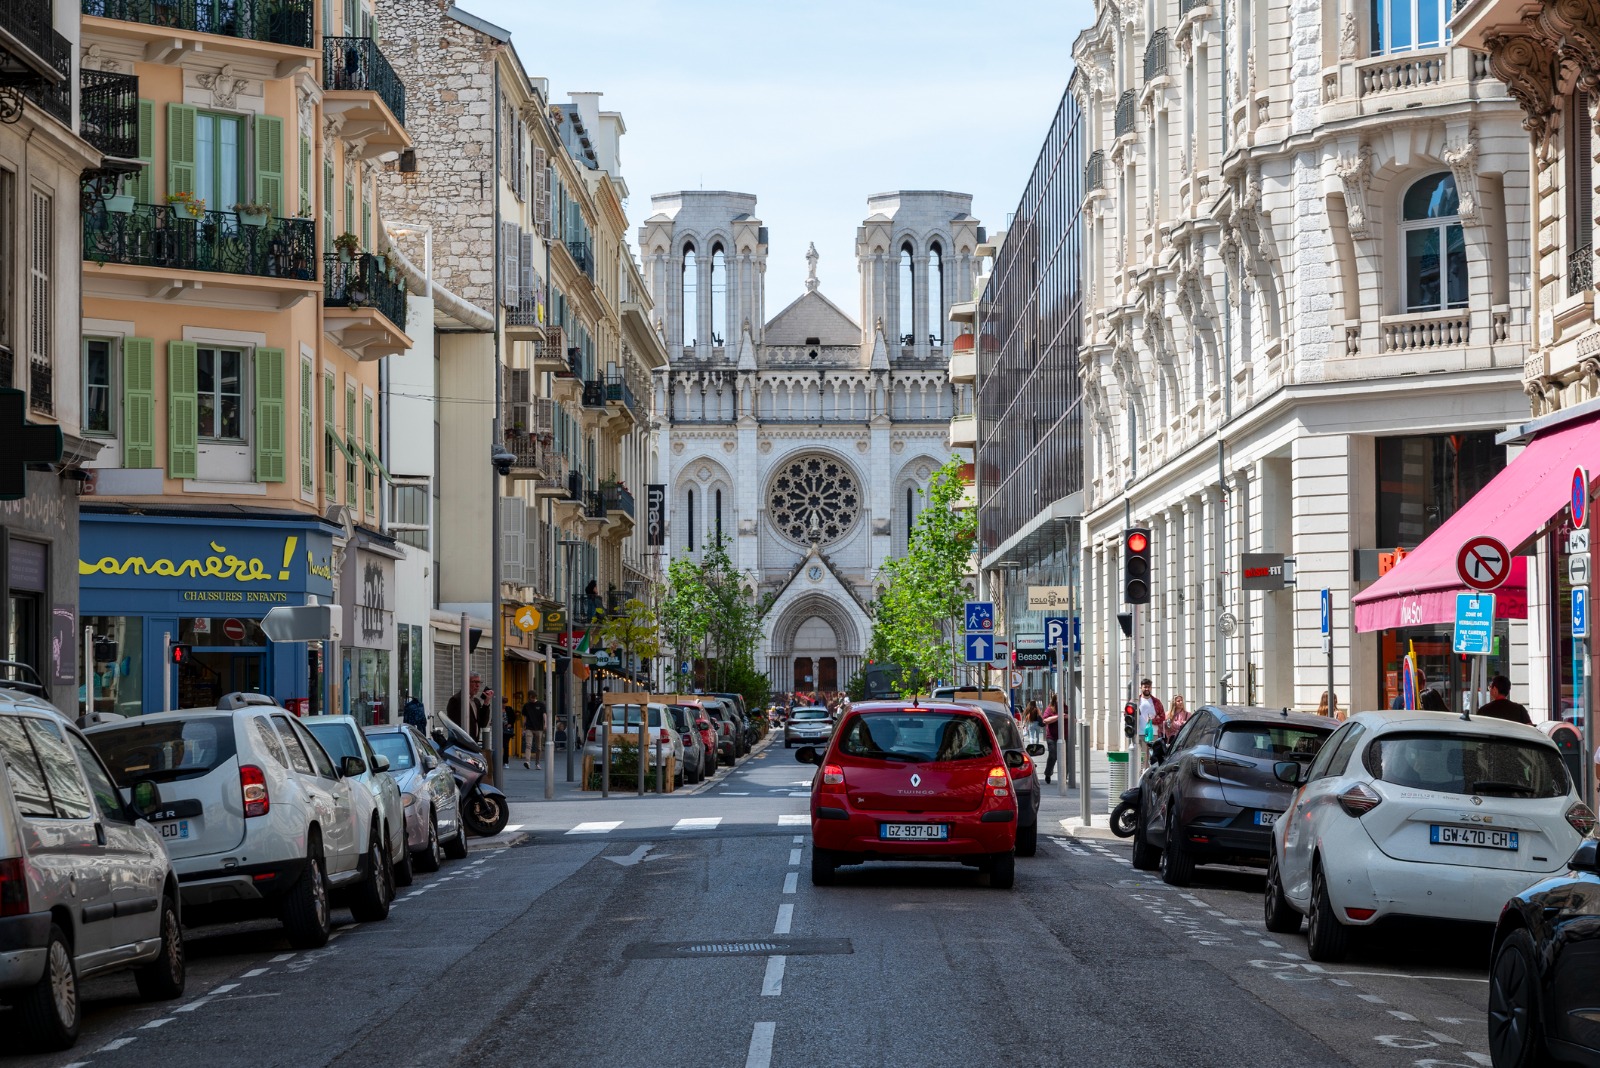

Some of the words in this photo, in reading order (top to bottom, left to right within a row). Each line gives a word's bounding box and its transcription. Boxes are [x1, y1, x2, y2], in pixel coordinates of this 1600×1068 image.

[649, 490, 663, 536] fnac
[79, 541, 272, 581] ananère
[184, 591, 242, 601] CHAUSSURES
[247, 592, 287, 601] ENFANTS
[1322, 597, 1327, 626] P
[1048, 623, 1062, 644] P
[888, 825, 939, 837] GZ-937-QJ
[1442, 828, 1508, 846] GW-470-CH
